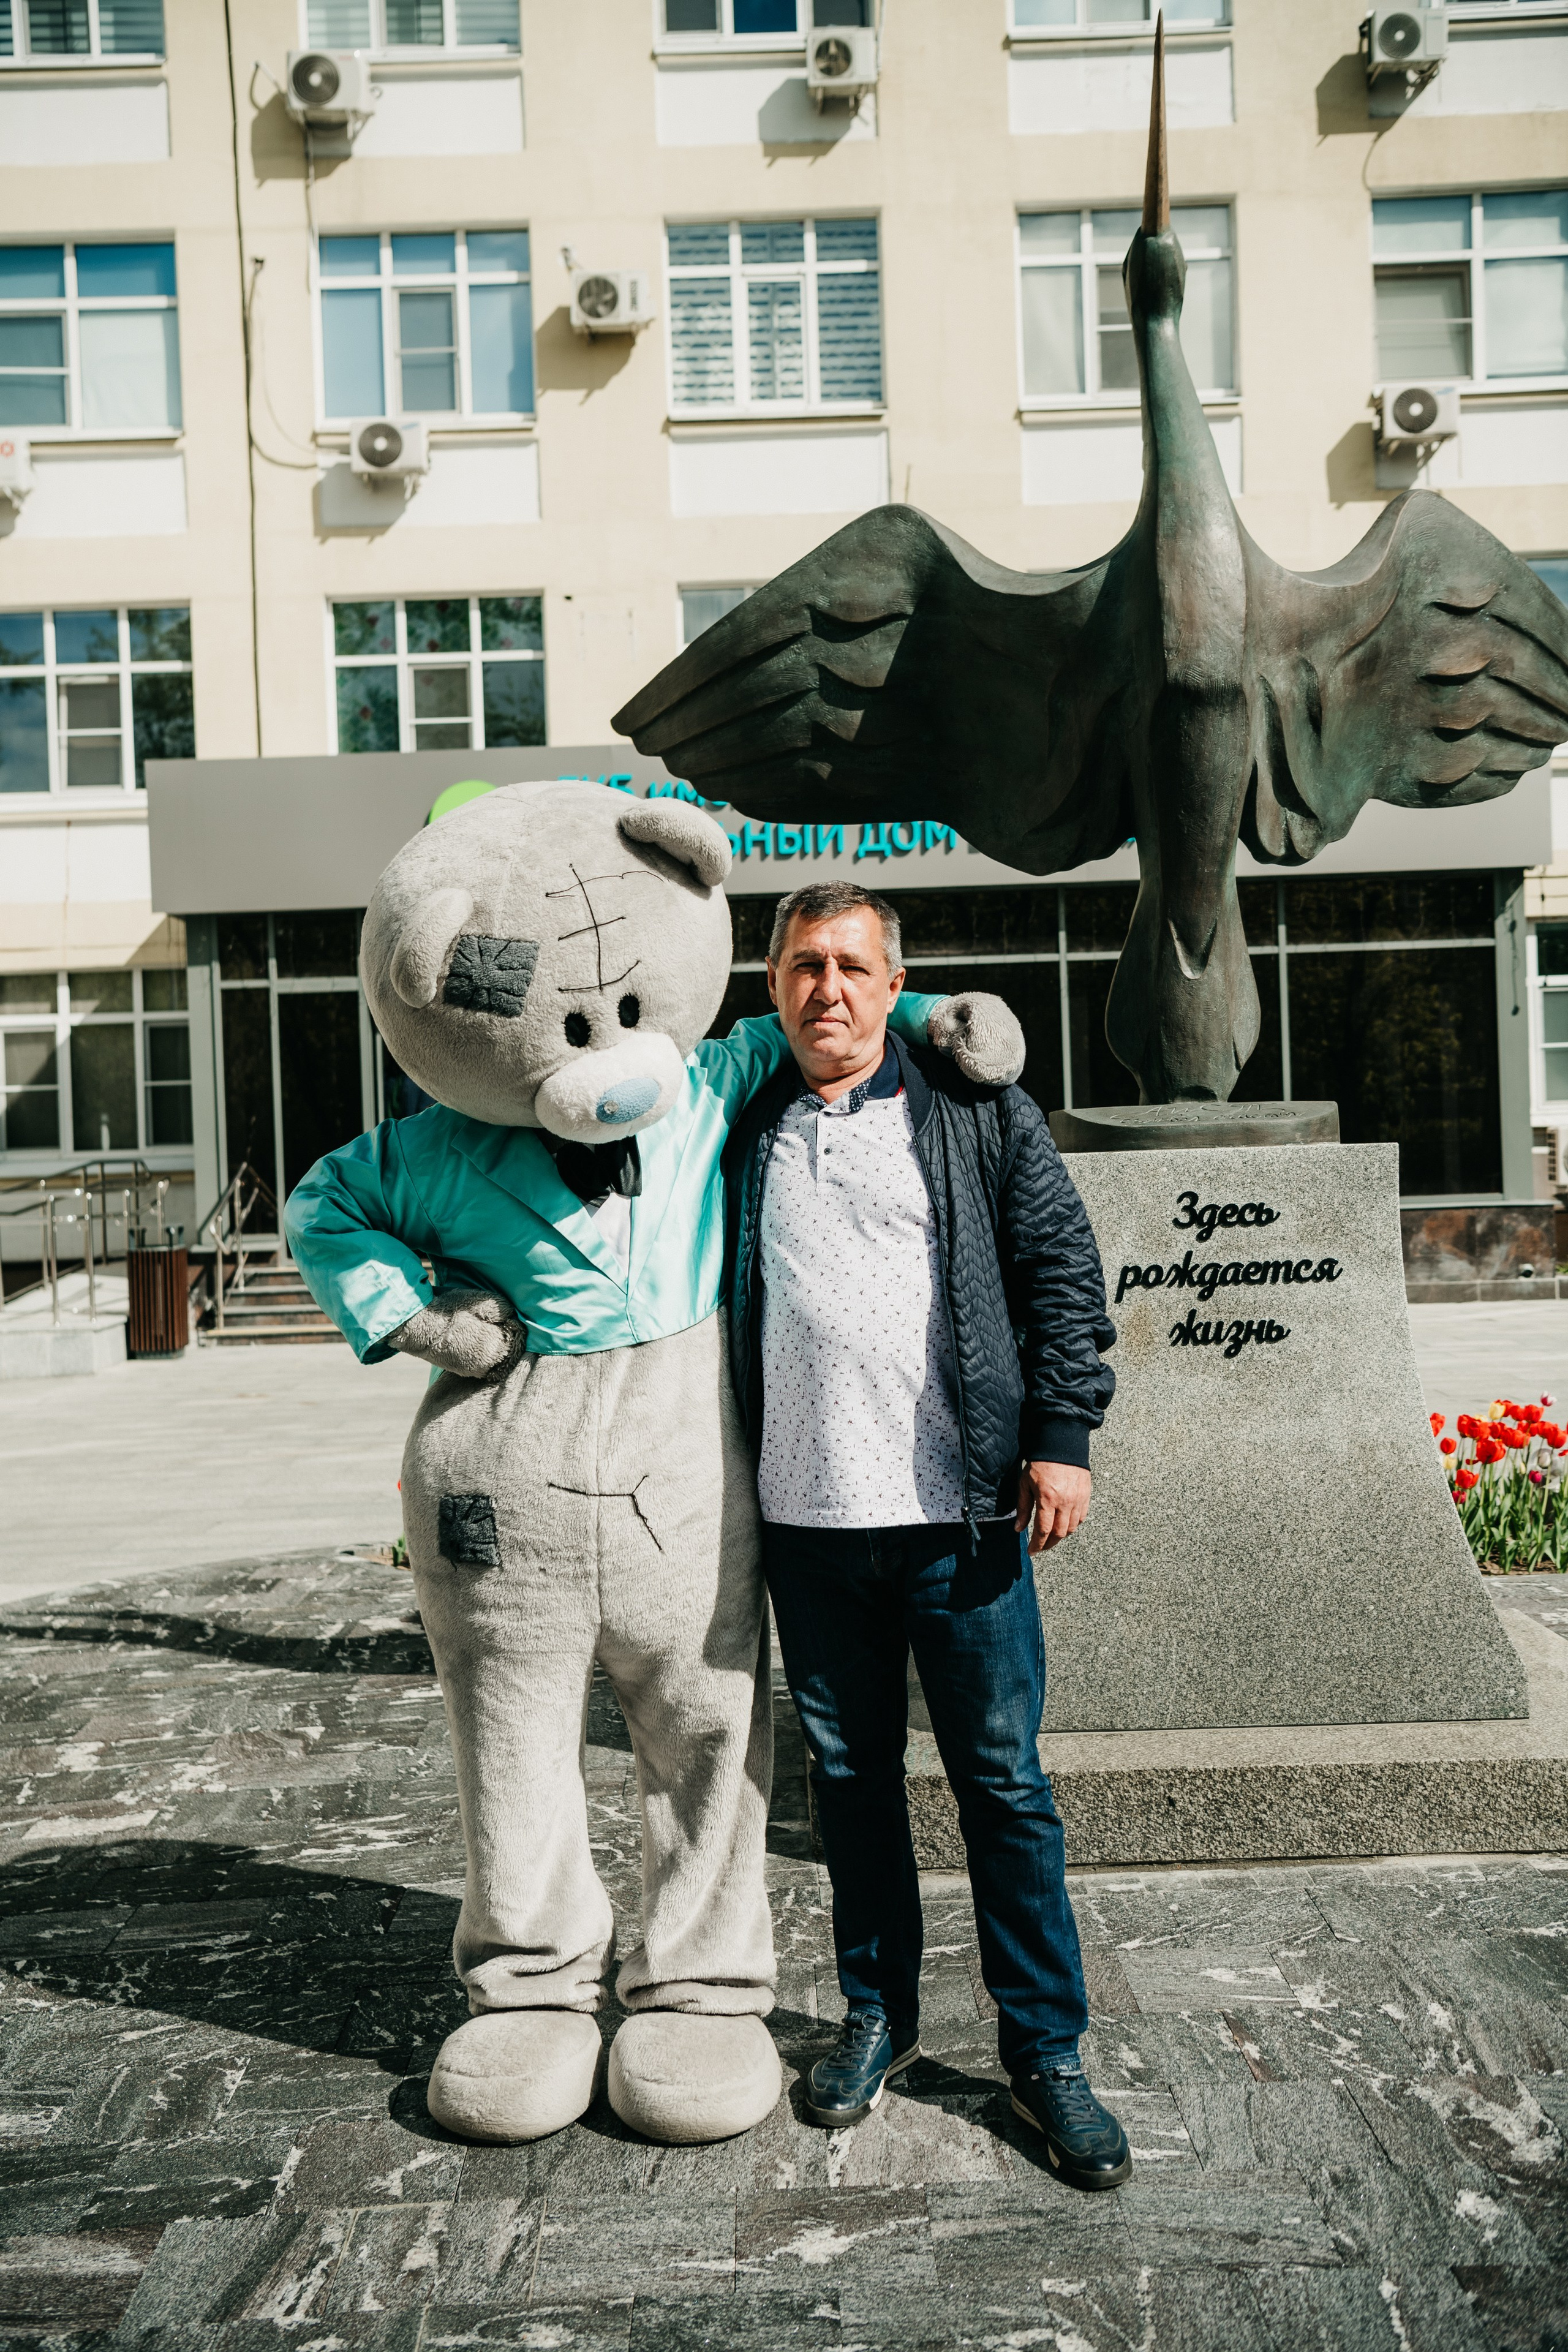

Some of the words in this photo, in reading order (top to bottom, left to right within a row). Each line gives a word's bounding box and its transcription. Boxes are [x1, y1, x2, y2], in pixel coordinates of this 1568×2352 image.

[1172, 1191, 1281, 1242] Здесь
[1114, 1251, 1343, 1303] рождается
[1169, 1309, 1291, 1359] жизнь
